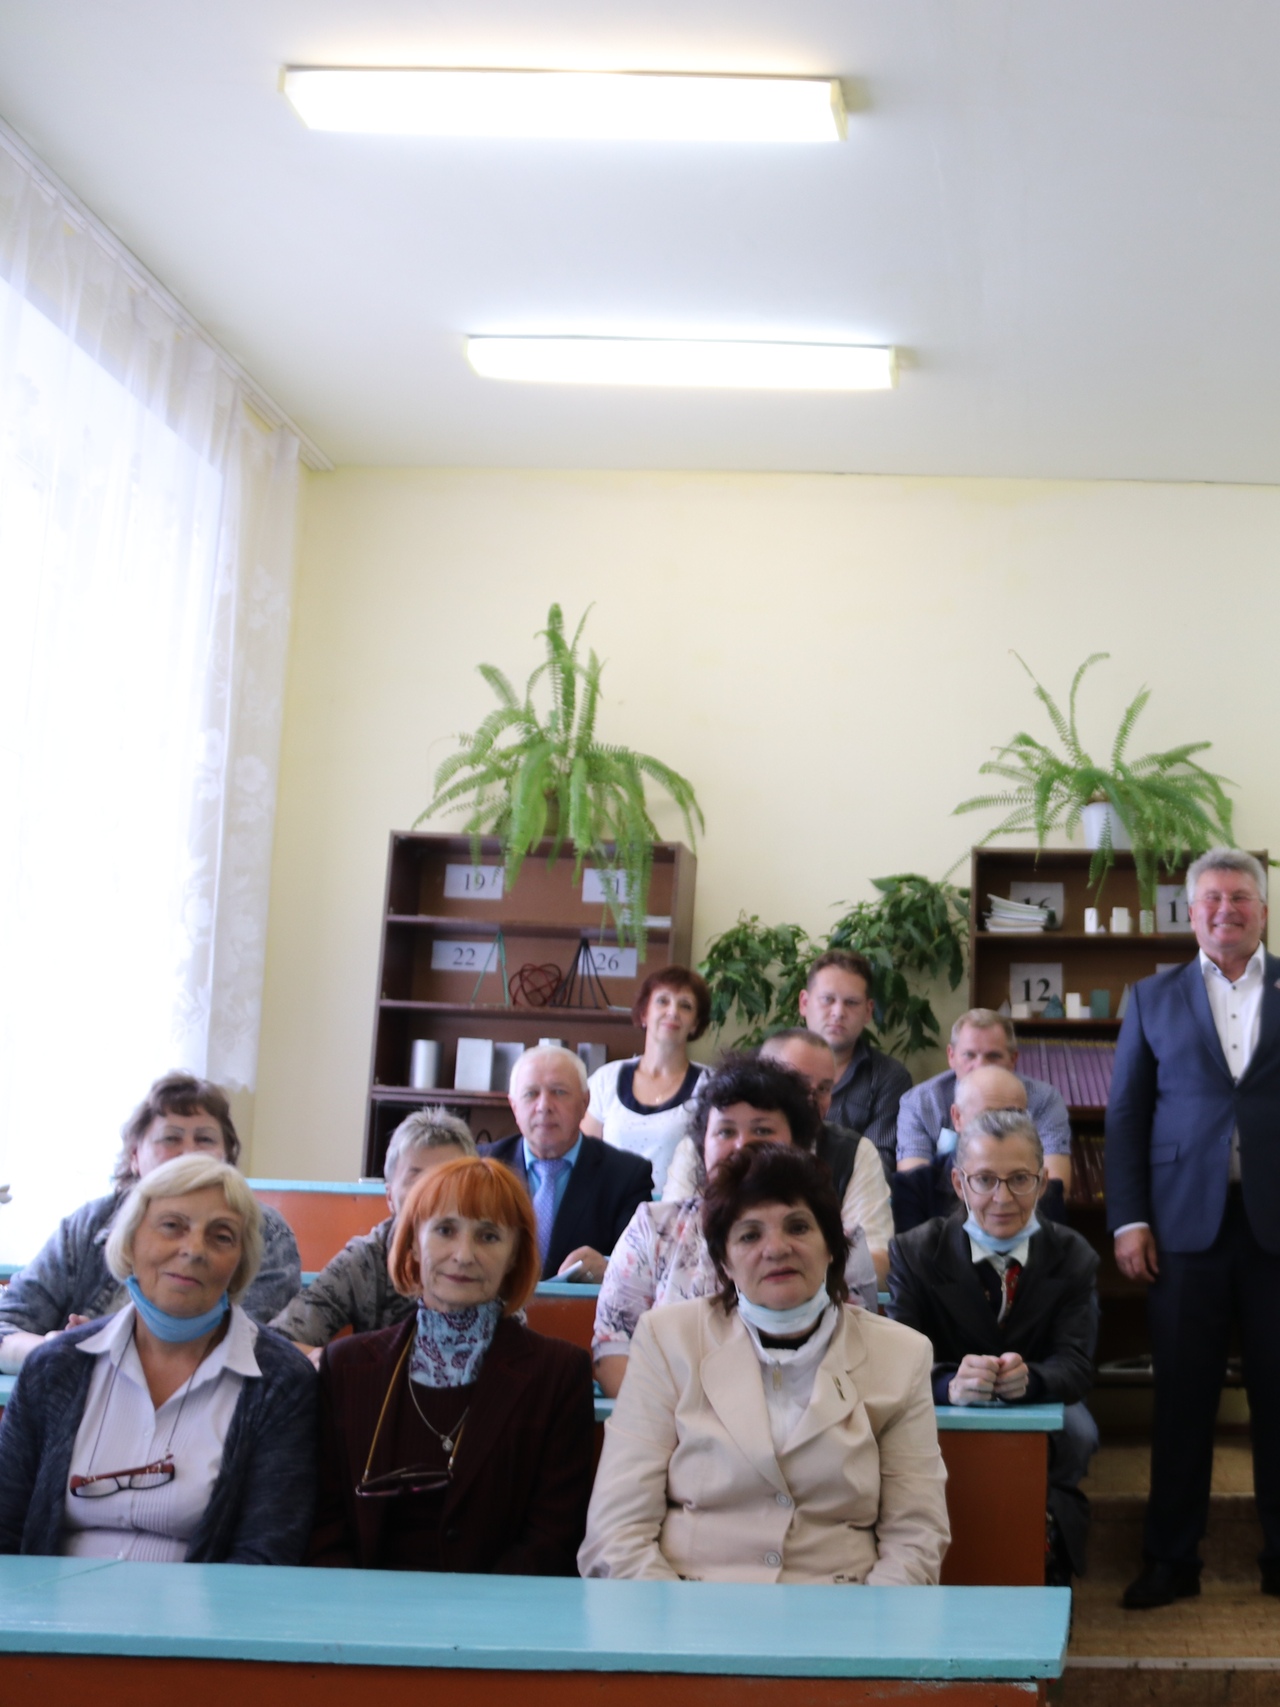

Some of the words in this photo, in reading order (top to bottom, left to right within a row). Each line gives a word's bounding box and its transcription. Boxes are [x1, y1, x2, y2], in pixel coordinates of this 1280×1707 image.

[464, 873, 485, 890] 19
[453, 947, 475, 966] 22
[596, 953, 619, 971] 26
[1022, 977, 1050, 1001] 12
